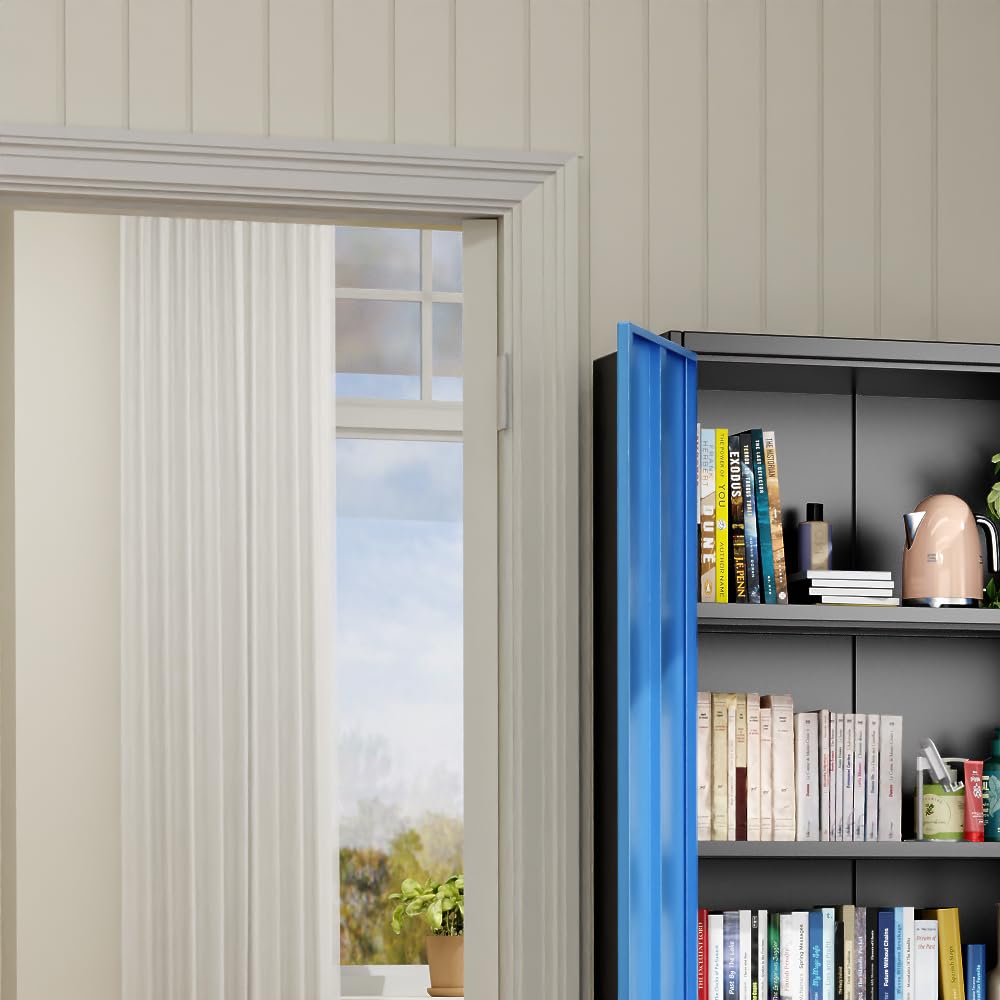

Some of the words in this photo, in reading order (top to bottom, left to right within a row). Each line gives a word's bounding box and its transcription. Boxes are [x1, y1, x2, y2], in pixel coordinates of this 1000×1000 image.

[765, 438, 773, 448] THE
[730, 451, 742, 498] EXODUS
[766, 448, 776, 479] HISTORIAN
[718, 484, 726, 508] YOU
[703, 504, 716, 564] DUNE
[736, 570, 746, 598] PENN
[729, 970, 737, 979] By
[949, 962, 957, 983] Spanish
